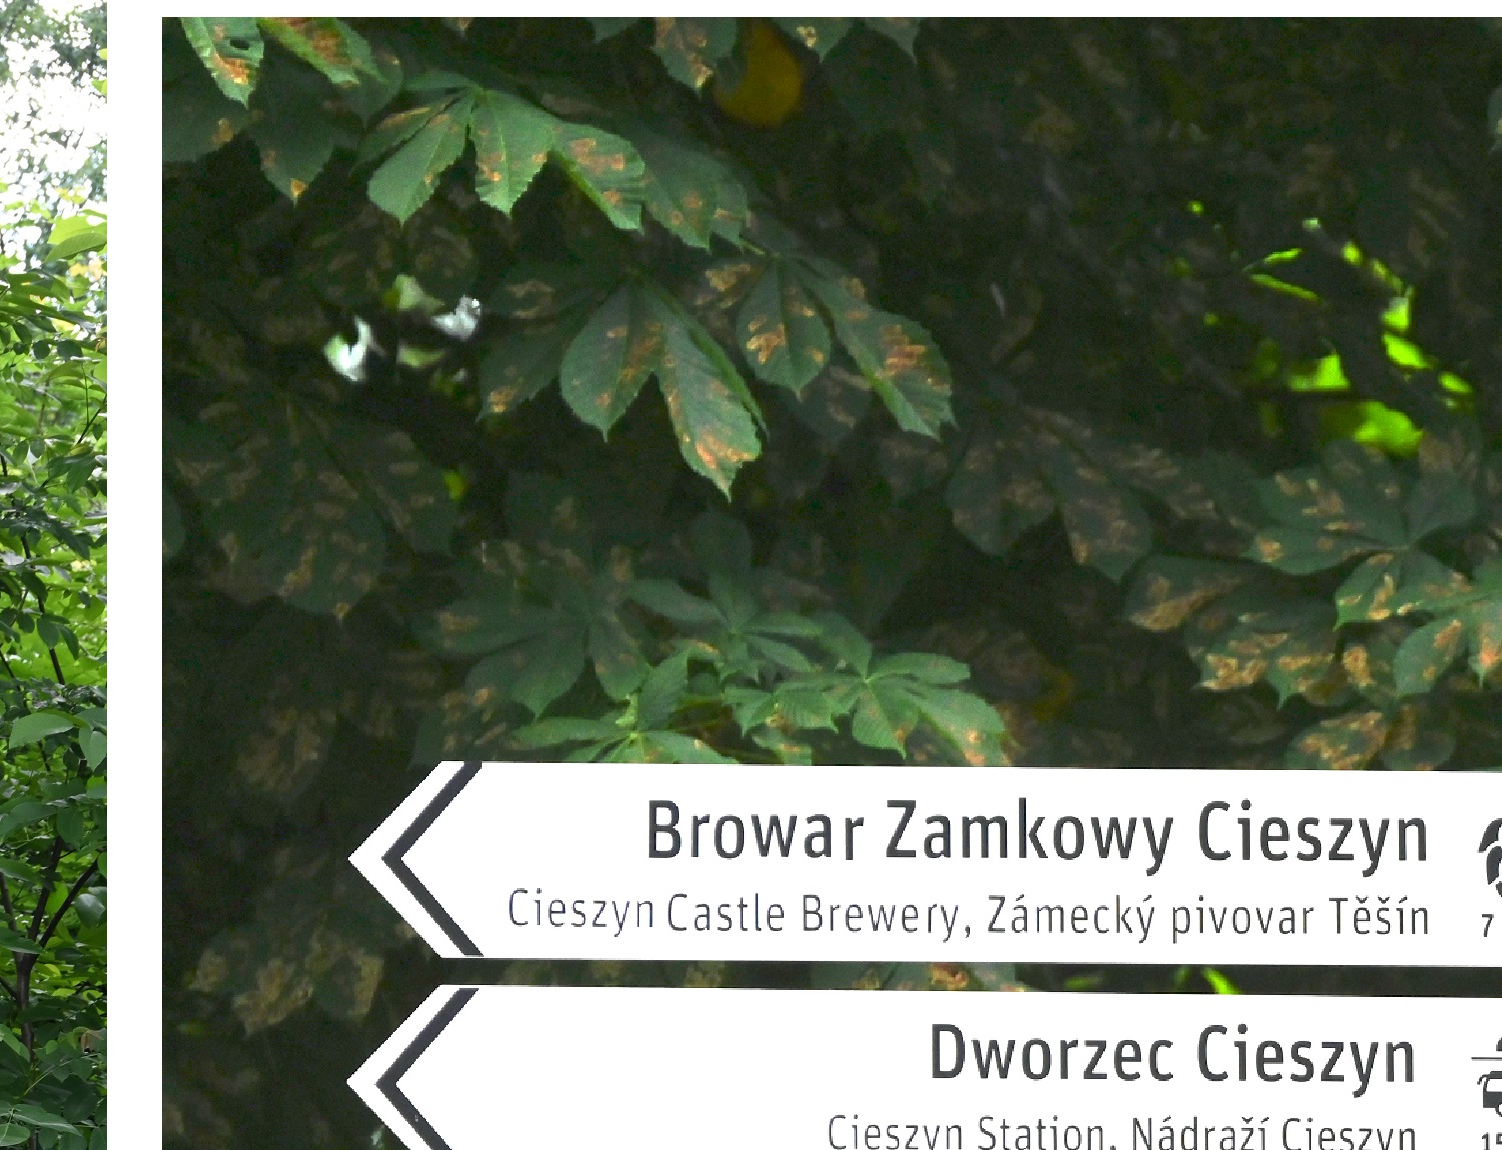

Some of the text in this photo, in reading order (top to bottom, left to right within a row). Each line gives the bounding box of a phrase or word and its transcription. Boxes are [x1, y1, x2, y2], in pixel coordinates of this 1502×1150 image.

[648, 797, 1427, 878] Browar Zamkowy Cieszyn
[508, 887, 1429, 945] Cieszyn Castle Brewery, Zámecký pivovar Těšín
[1481, 913, 1495, 938] 7
[931, 1023, 1415, 1099] Dworzec Cieszyn
